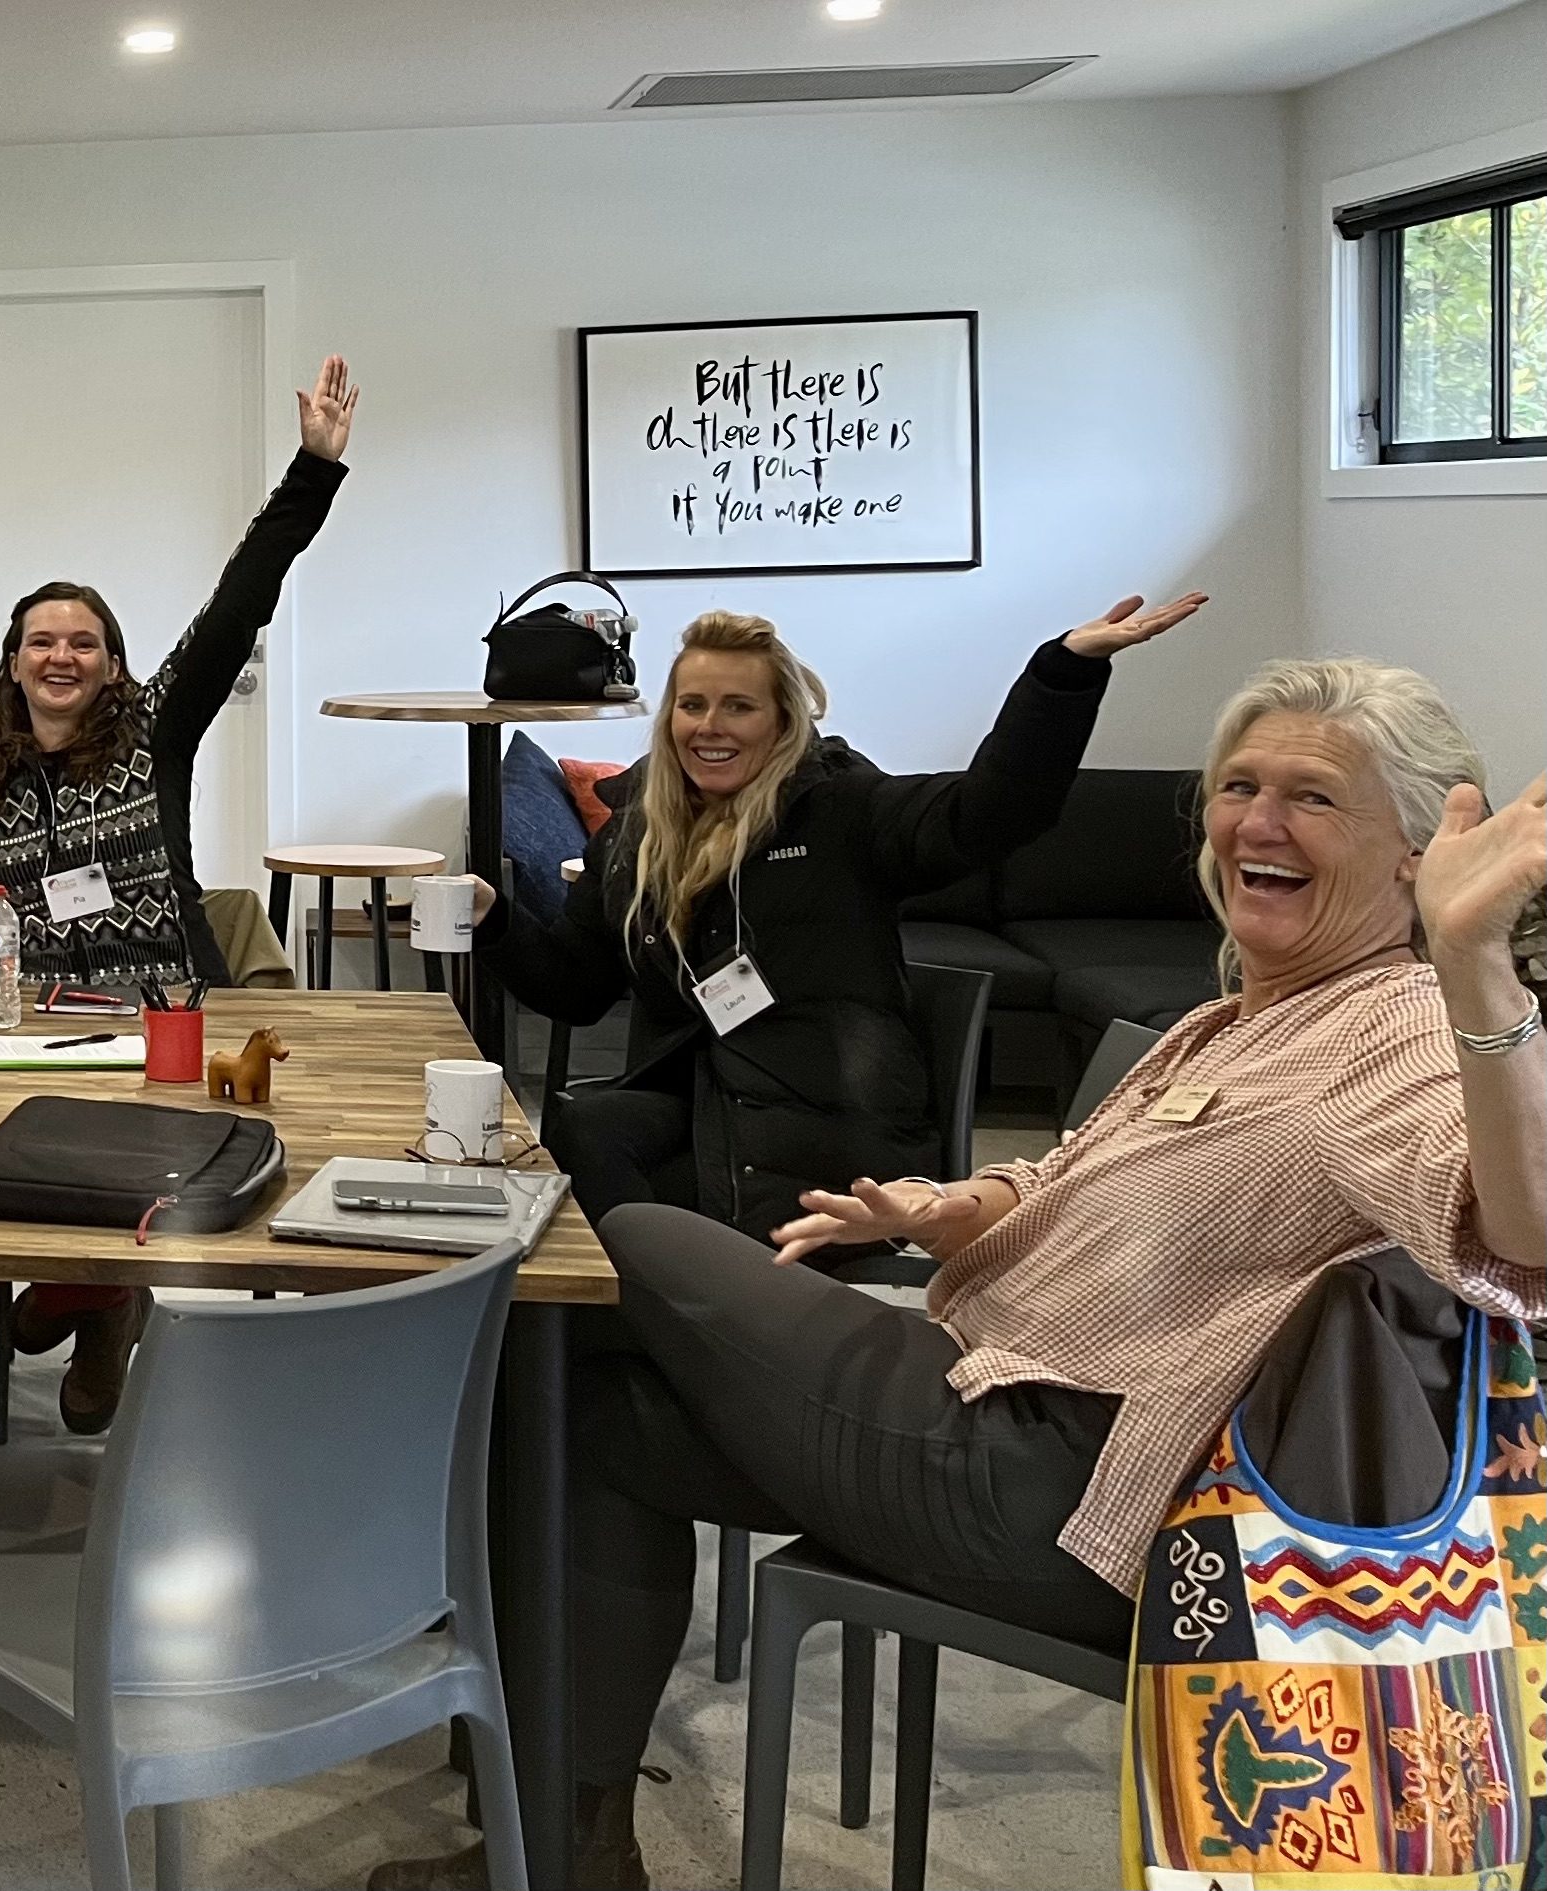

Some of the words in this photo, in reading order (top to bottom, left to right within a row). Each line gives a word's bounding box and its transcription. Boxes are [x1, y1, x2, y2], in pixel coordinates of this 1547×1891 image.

[695, 354, 760, 419] But
[761, 359, 845, 411] there
[856, 362, 884, 407] is
[646, 406, 694, 451] Oh
[692, 411, 760, 459] there
[772, 412, 798, 451] is
[804, 407, 880, 455] there
[890, 418, 913, 450] is
[712, 460, 732, 484] a
[672, 482, 698, 536] if
[774, 494, 844, 528] make
[853, 493, 903, 517] one
